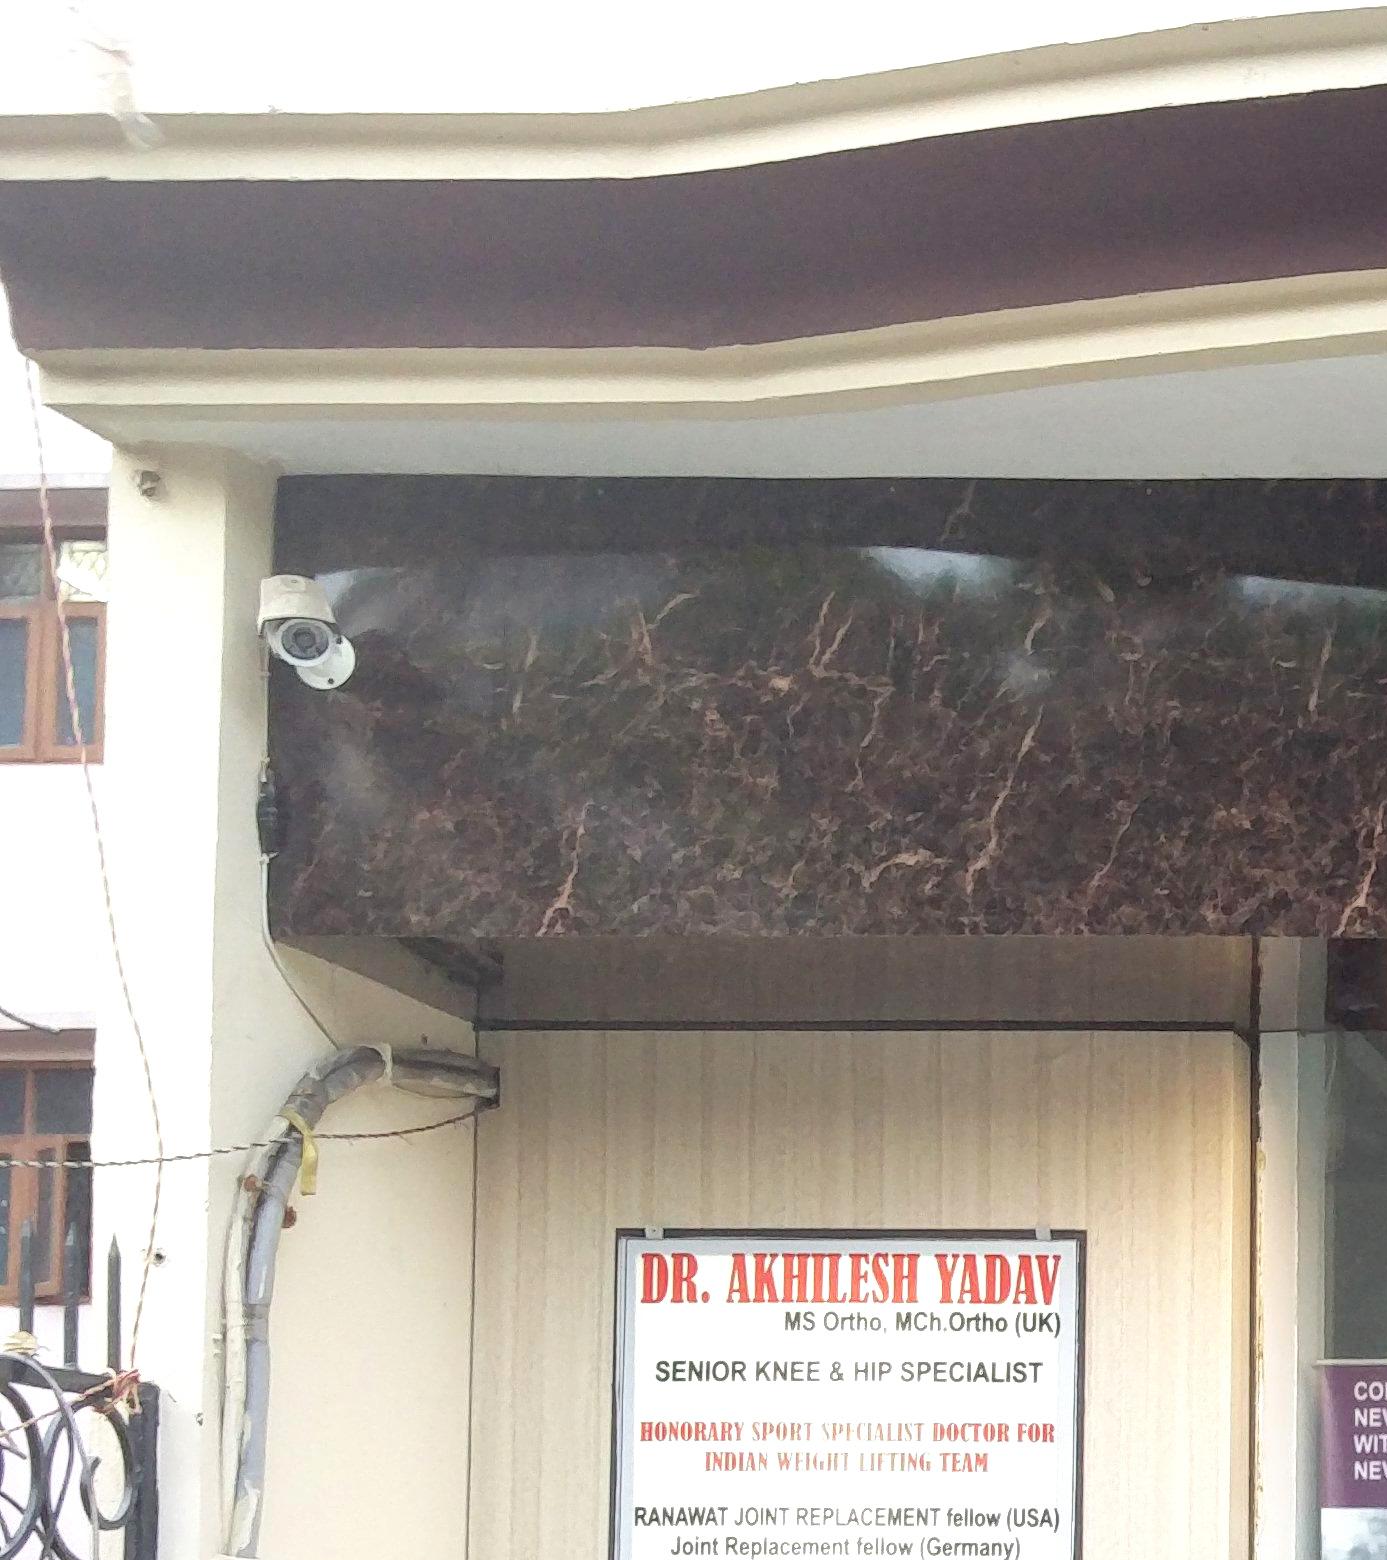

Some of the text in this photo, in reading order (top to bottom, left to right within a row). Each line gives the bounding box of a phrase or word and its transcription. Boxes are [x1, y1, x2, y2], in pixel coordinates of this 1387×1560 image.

[640, 1253, 1061, 1305] DR. AKHILESH YADAV
[785, 1313, 815, 1331] MS
[824, 1312, 887, 1333] Ortho,
[1015, 1312, 1061, 1338] (UK)
[655, 1361, 1043, 1383] SENIOR KNEE & HIP SPECIALIST
[640, 1421, 1055, 1443] HONORARY SPORT SPECIALIST DOCTOR FOR
[705, 1451, 768, 1471] INDIAN
[859, 1452, 931, 1472] LIFTING
[939, 1452, 989, 1472] TEAM
[634, 1506, 1060, 1531] RANAWAT JOINT REPLACEMENT fellow (USA)
[670, 1536, 1021, 1560] Joint Replacement fellow (Germany)
